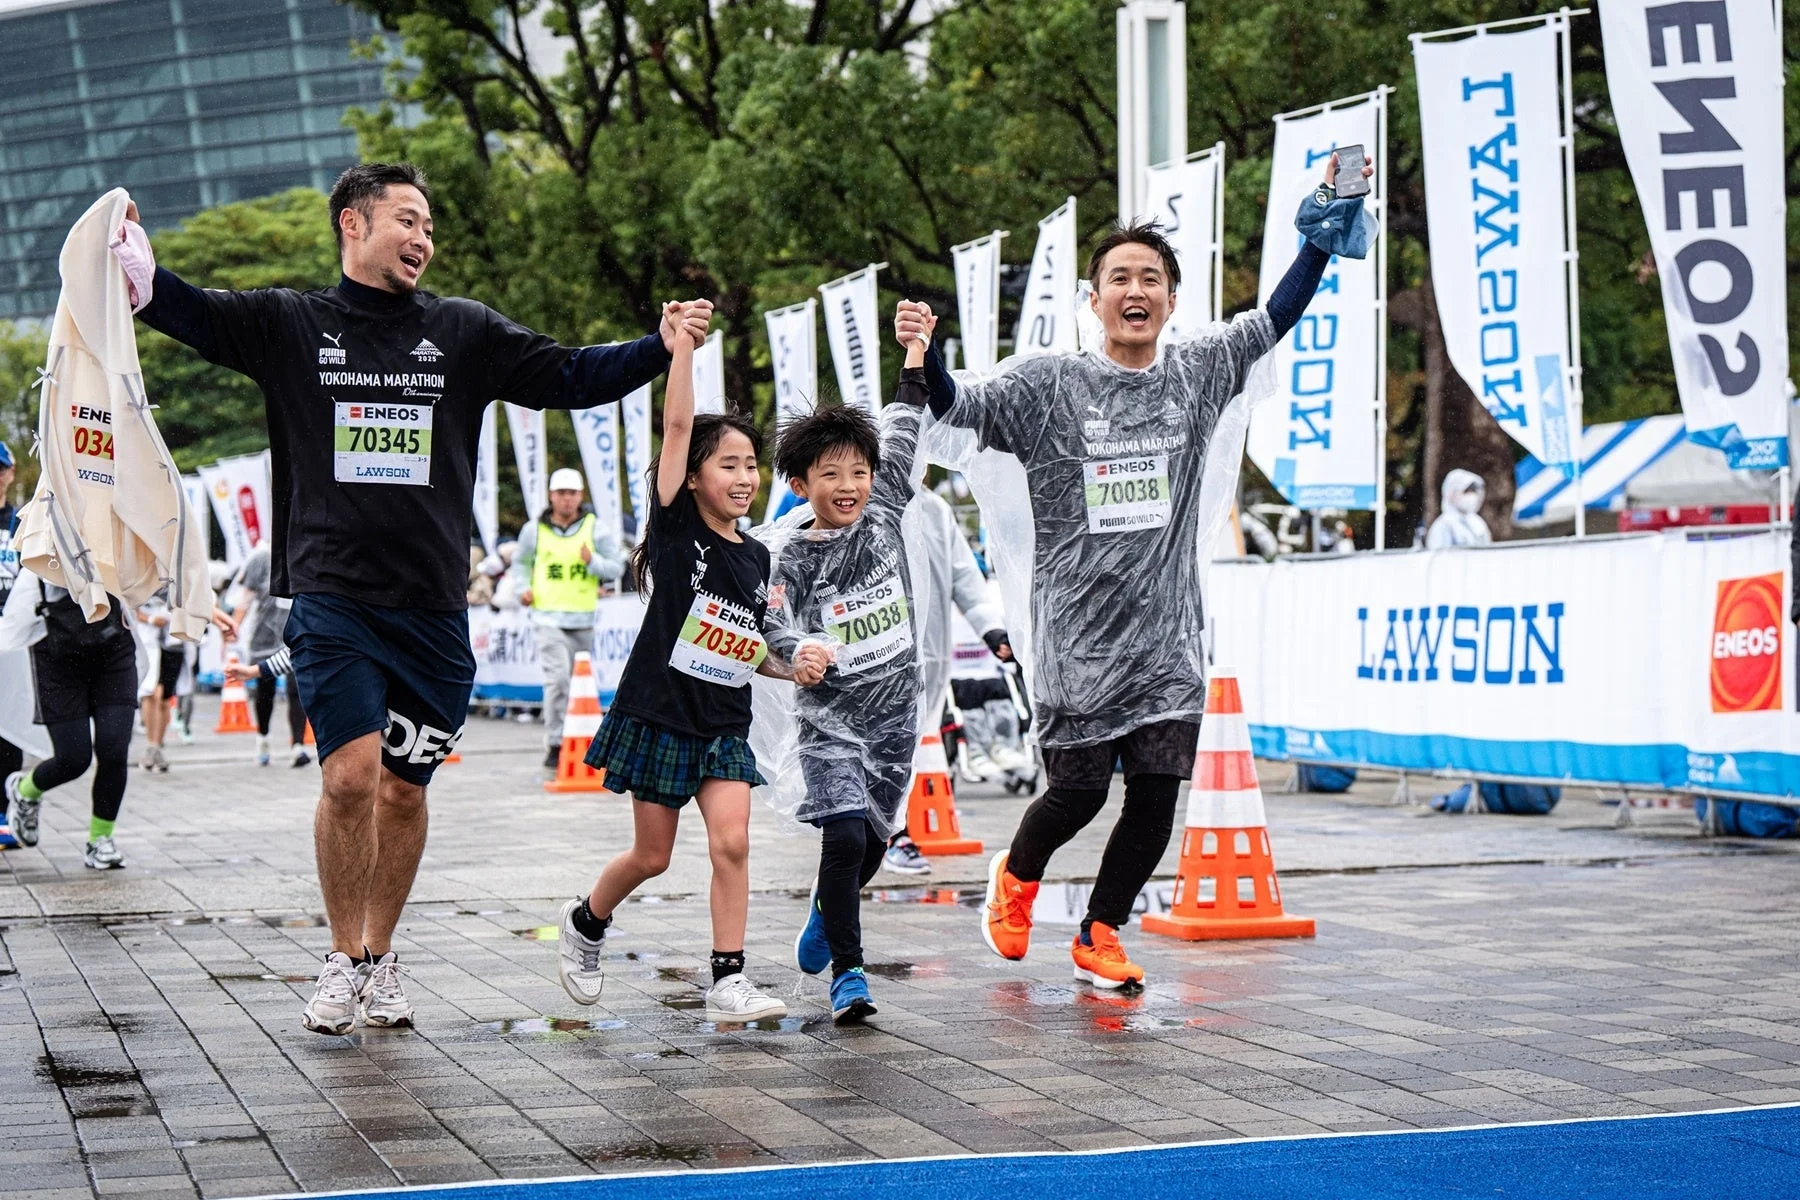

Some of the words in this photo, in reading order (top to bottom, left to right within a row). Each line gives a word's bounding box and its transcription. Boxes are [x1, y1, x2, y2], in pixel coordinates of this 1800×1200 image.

[319, 348, 346, 357] PUMA
[329, 357, 346, 365] WILD
[319, 372, 381, 387] YOKOHAMA
[384, 374, 445, 388] MARATHON
[364, 407, 419, 421] ENEOS
[349, 427, 420, 454] 70345
[1086, 440, 1140, 455] YOKOHAMA
[356, 467, 410, 478] LAWSON
[1109, 460, 1155, 475] ENEOS
[1098, 478, 1159, 506] 70038
[1100, 517, 1126, 528] PUMA
[548, 563, 587, 580] 案内
[838, 602, 901, 645] 70038
[692, 620, 760, 662] 70345
[1357, 602, 1564, 684] LAWSON
[1713, 626, 1778, 659] ENEOS
[689, 660, 734, 681] LAWSON
